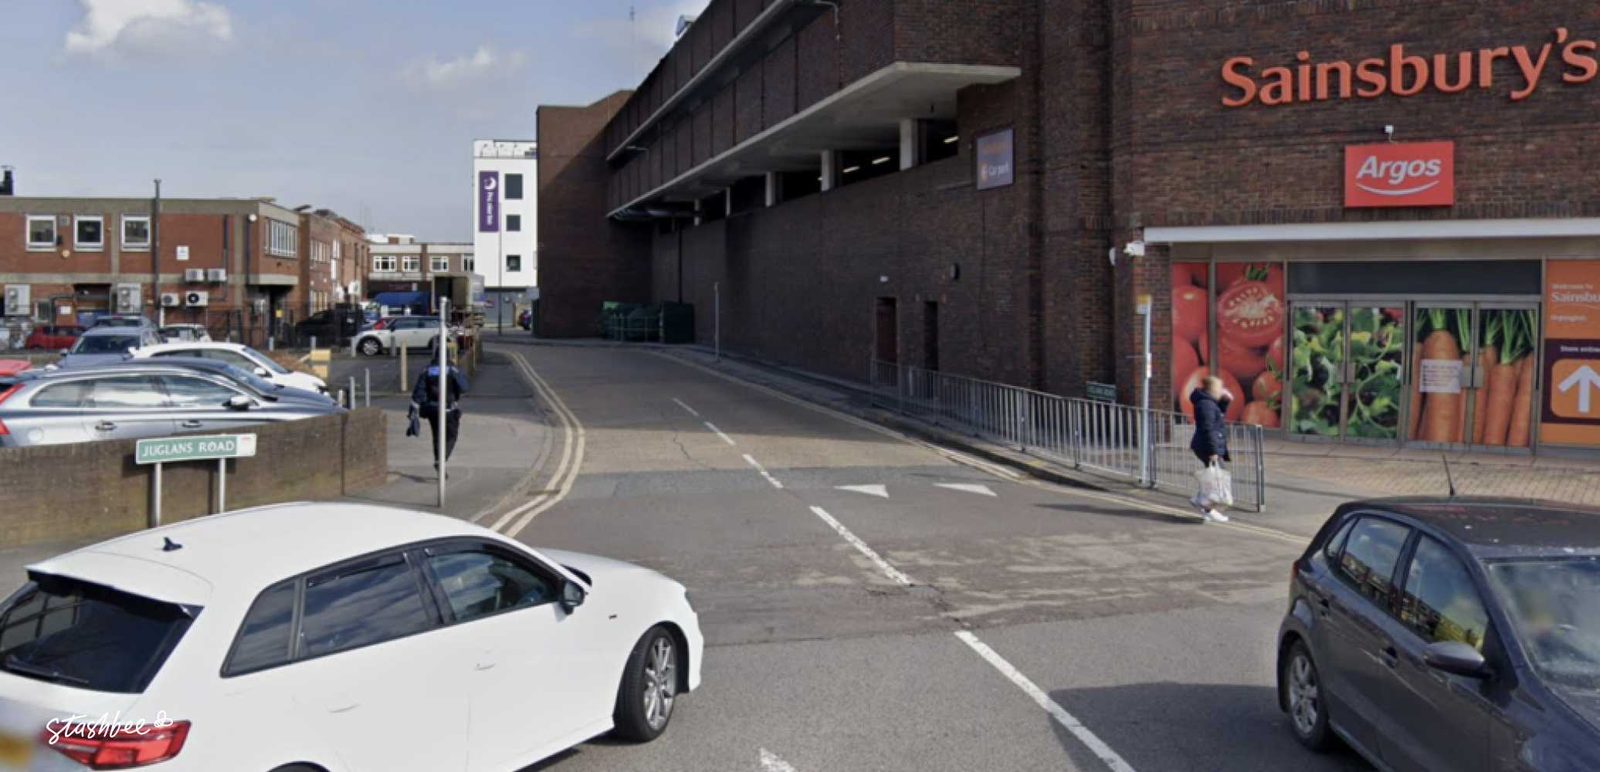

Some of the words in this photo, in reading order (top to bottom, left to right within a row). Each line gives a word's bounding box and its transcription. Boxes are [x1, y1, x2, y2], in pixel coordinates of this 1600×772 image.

[1221, 27, 1598, 107] Sainsbury's
[1357, 155, 1441, 185] Argos
[143, 442, 193, 457] JUGLANS
[199, 440, 235, 453] ROAD
